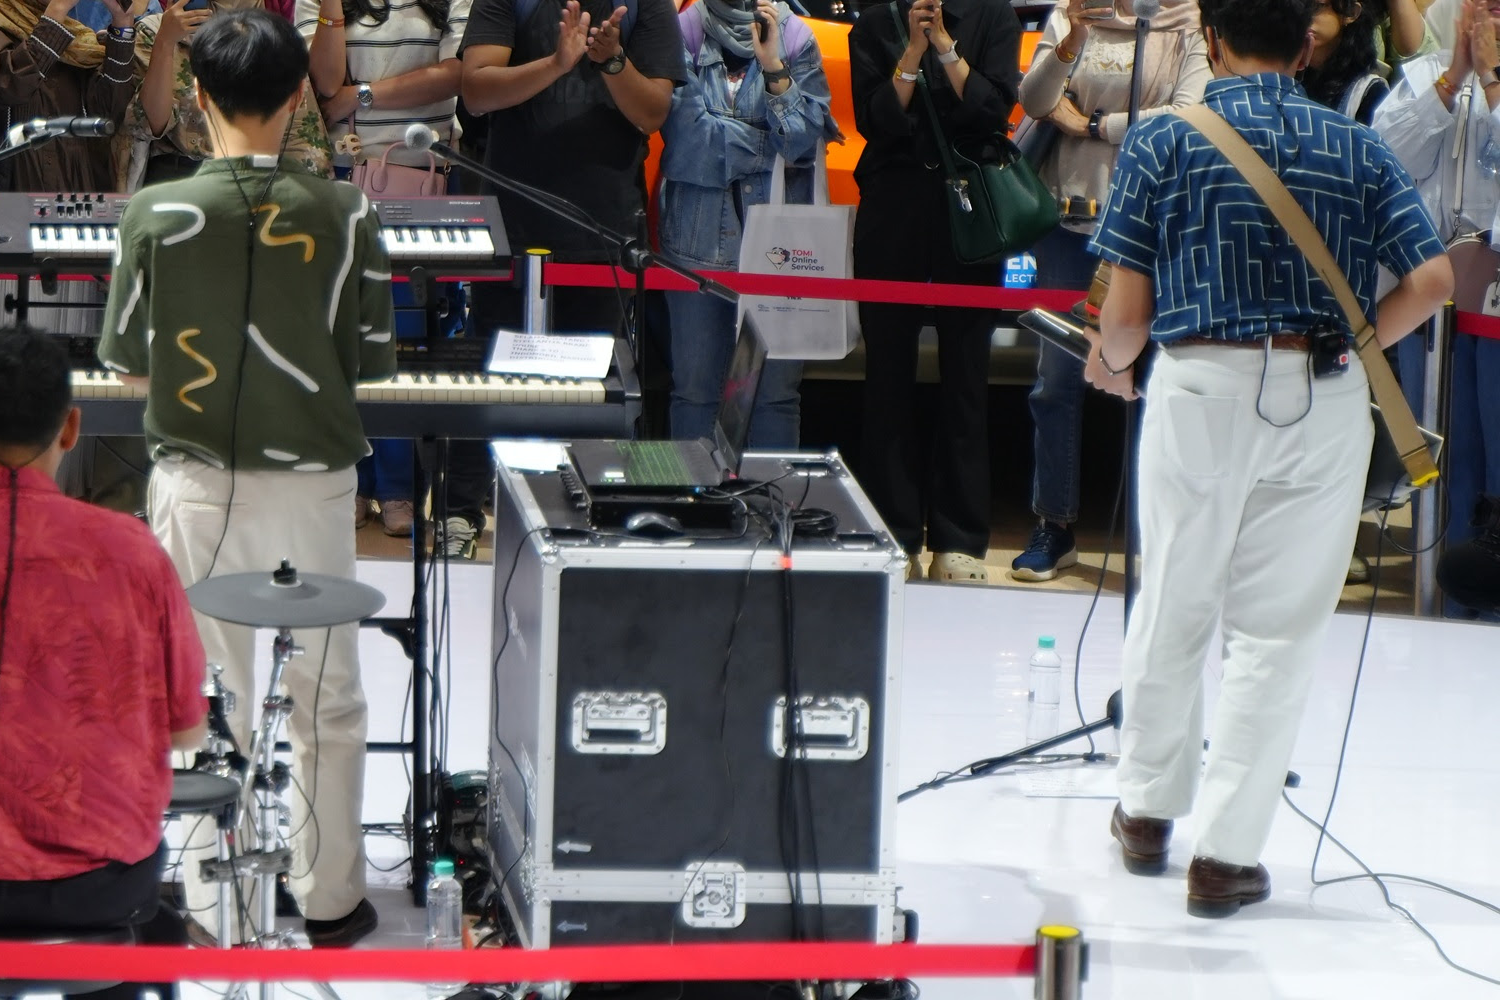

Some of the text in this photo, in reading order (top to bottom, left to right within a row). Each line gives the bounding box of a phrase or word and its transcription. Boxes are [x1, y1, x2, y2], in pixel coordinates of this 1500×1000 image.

[792, 249, 813, 257] TOMI
[791, 256, 818, 264] Online
[791, 263, 825, 271] Services
